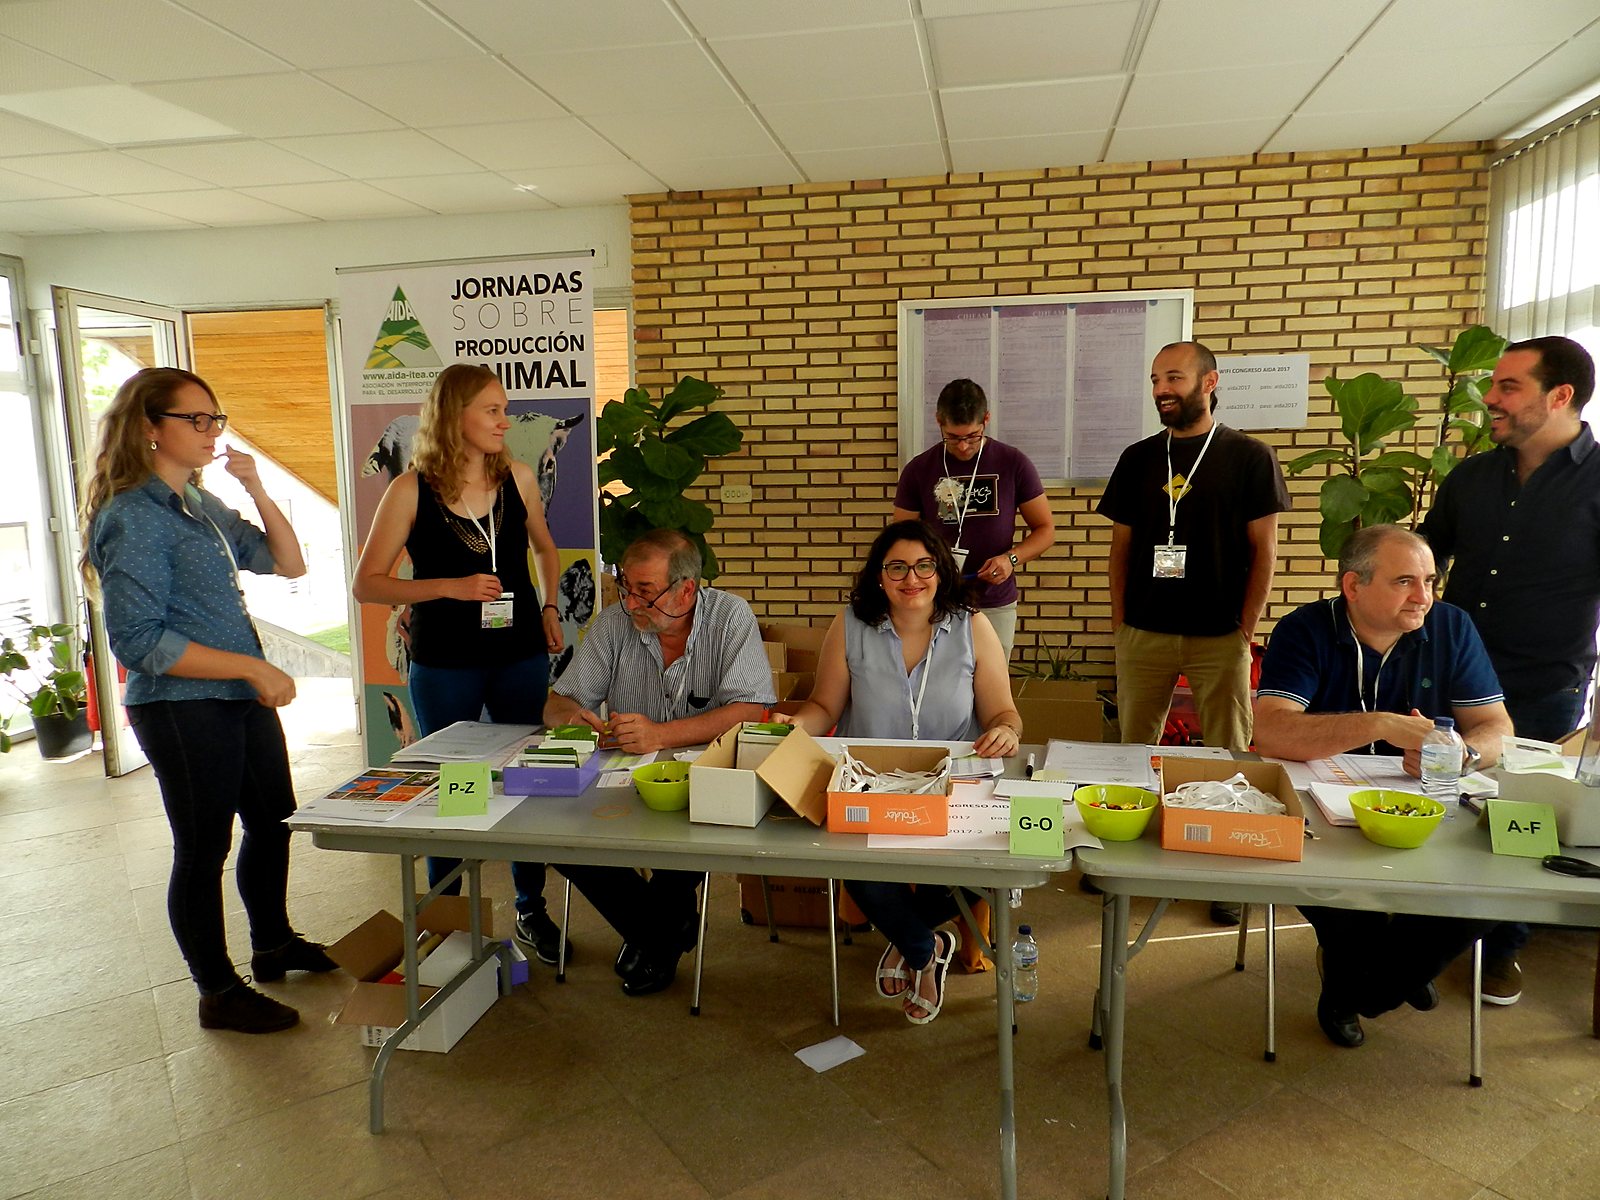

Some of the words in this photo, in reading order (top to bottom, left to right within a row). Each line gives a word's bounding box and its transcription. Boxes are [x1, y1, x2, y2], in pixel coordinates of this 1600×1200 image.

[450, 271, 583, 300] JORNADAS
[384, 300, 418, 321] AIDA
[452, 298, 584, 331] SOBRE
[455, 331, 585, 357] PRODUCCIÓN
[362, 371, 440, 381] www.aida-itea.or
[480, 359, 587, 391] NIMAL
[449, 781, 475, 795] P-Z
[884, 811, 921, 824] Folder
[1019, 816, 1053, 831] G-O
[1507, 820, 1541, 834] A-F
[1228, 831, 1271, 848] Folder
